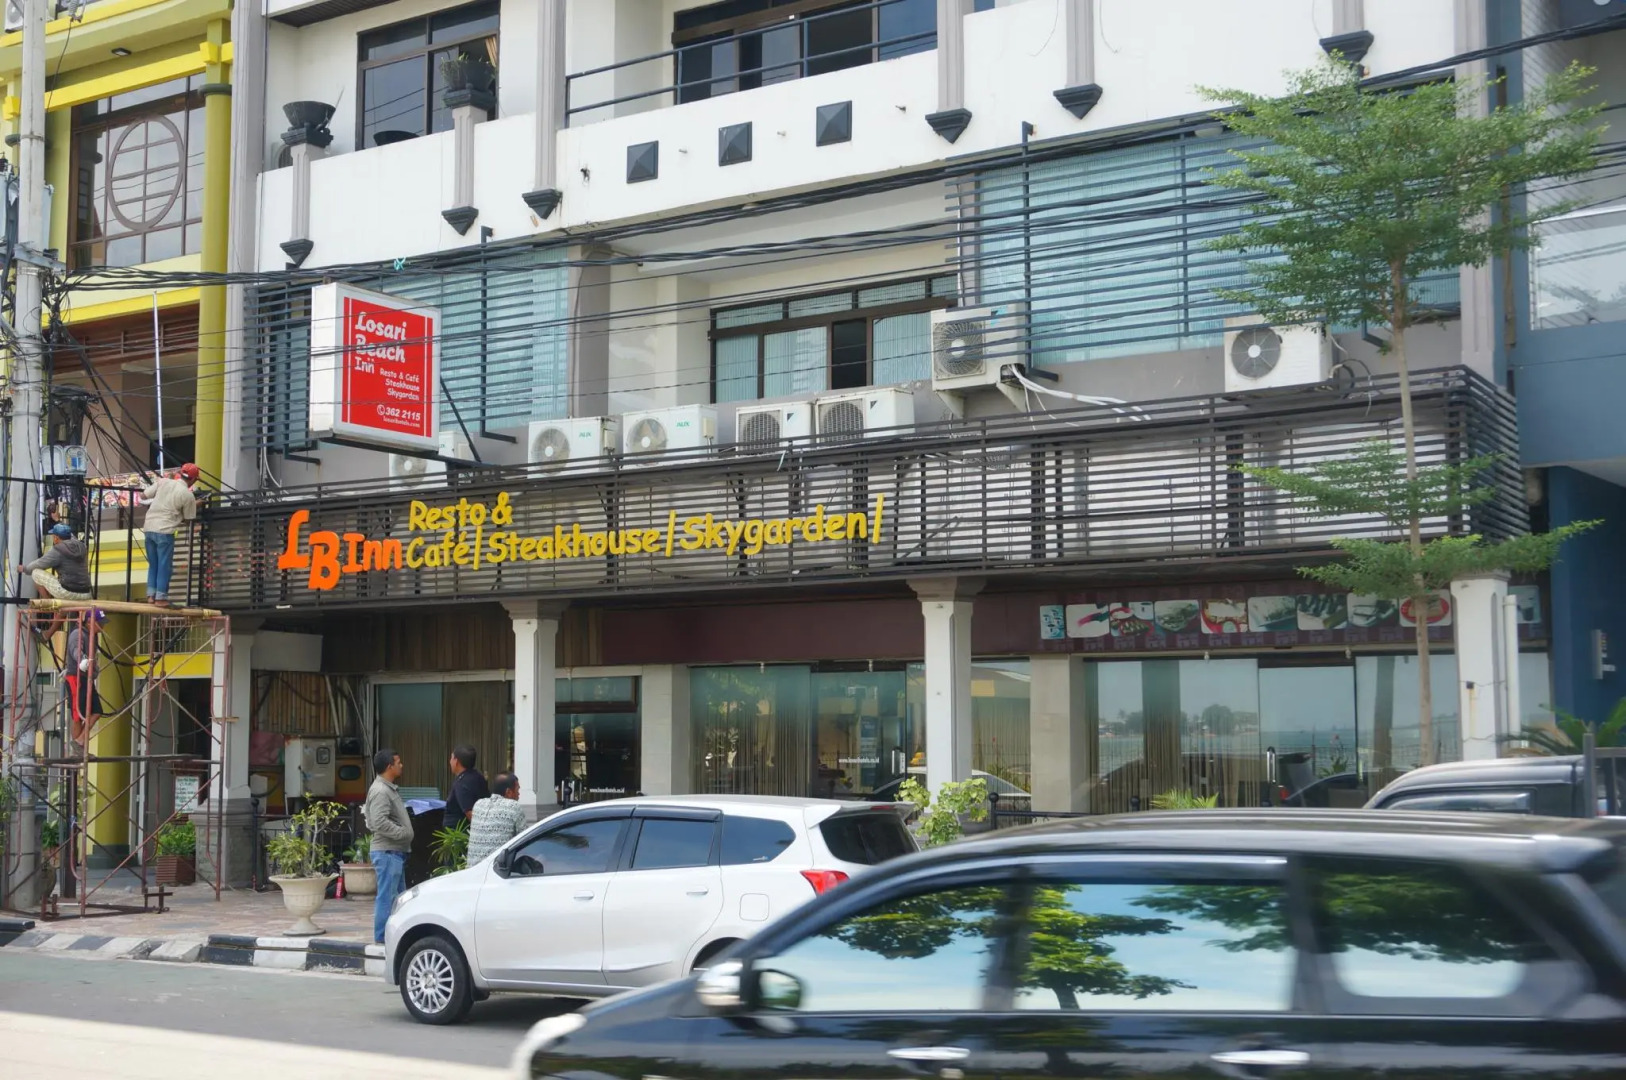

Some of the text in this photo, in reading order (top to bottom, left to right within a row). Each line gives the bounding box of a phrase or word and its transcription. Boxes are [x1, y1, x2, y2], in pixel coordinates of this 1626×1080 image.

[355, 311, 407, 341] Losari
[355, 333, 406, 363] Beach
[380, 367, 397, 379] Resto
[398, 372, 404, 380] &
[385, 378, 420, 392] Steakhouse
[387, 388, 420, 401] Skygarden
[385, 406, 421, 421] 362 2115
[408, 491, 513, 532] Resto &
